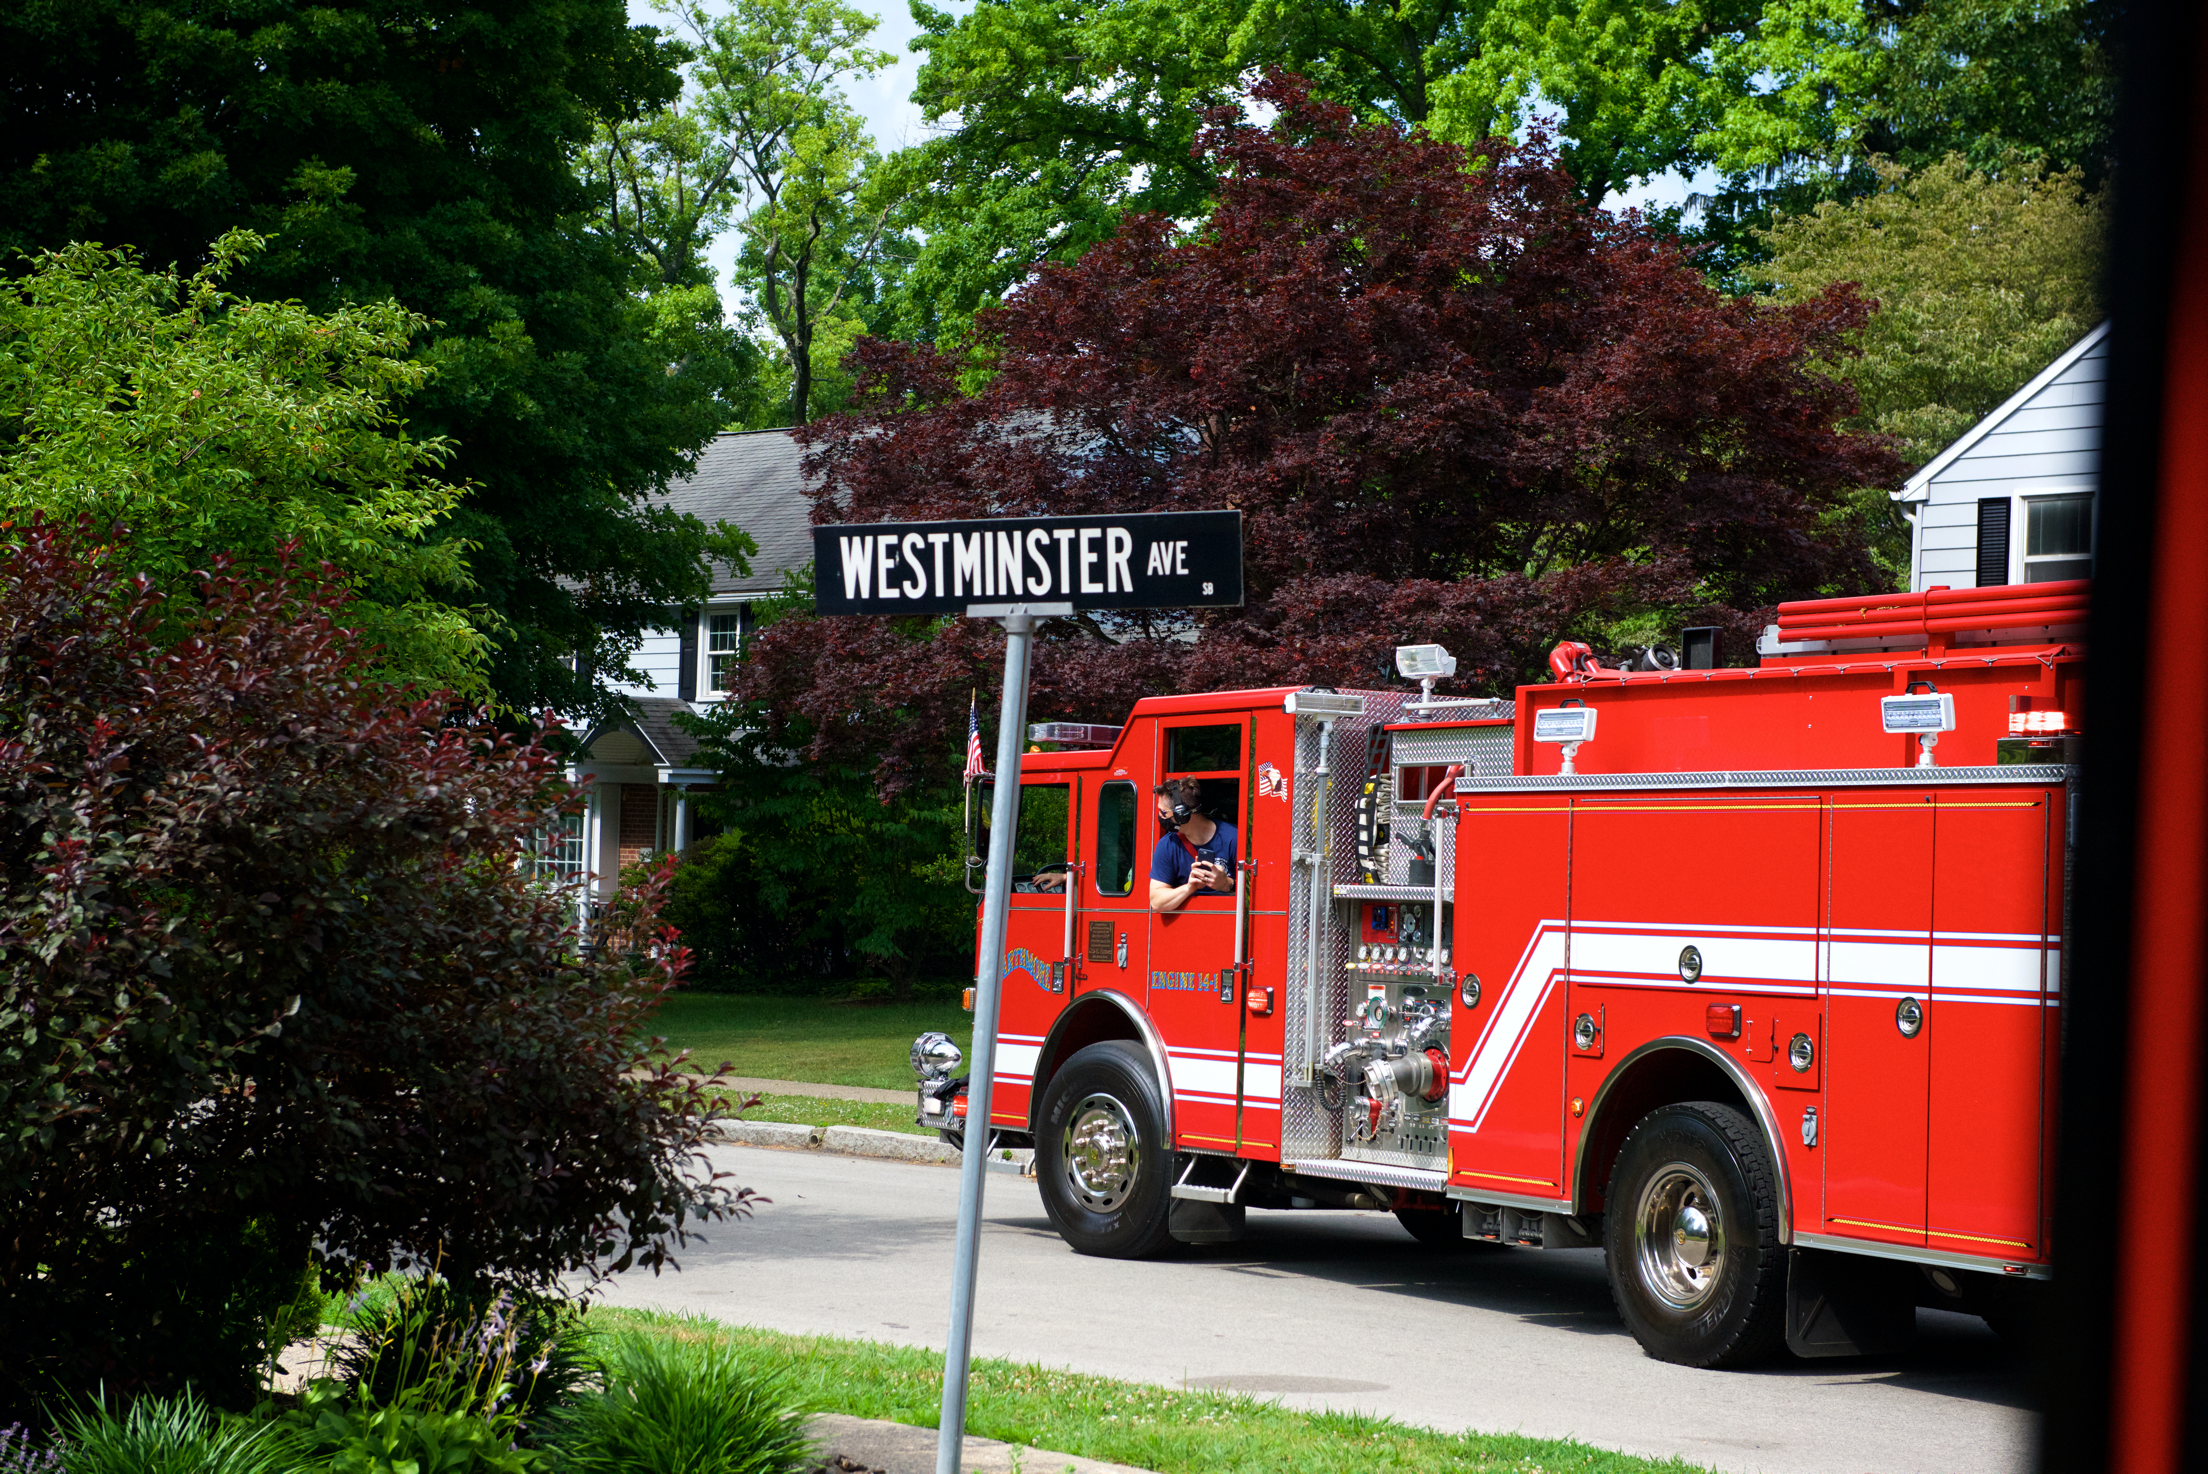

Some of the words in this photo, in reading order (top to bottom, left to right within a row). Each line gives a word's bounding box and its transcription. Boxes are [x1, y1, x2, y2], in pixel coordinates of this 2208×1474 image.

[839, 526, 1134, 600] WESTMINSTER
[1146, 540, 1189, 576] AVE
[1202, 581, 1214, 596] SB
[1150, 970, 1195, 991] ENGINE
[1197, 972, 1219, 992] 14-1
